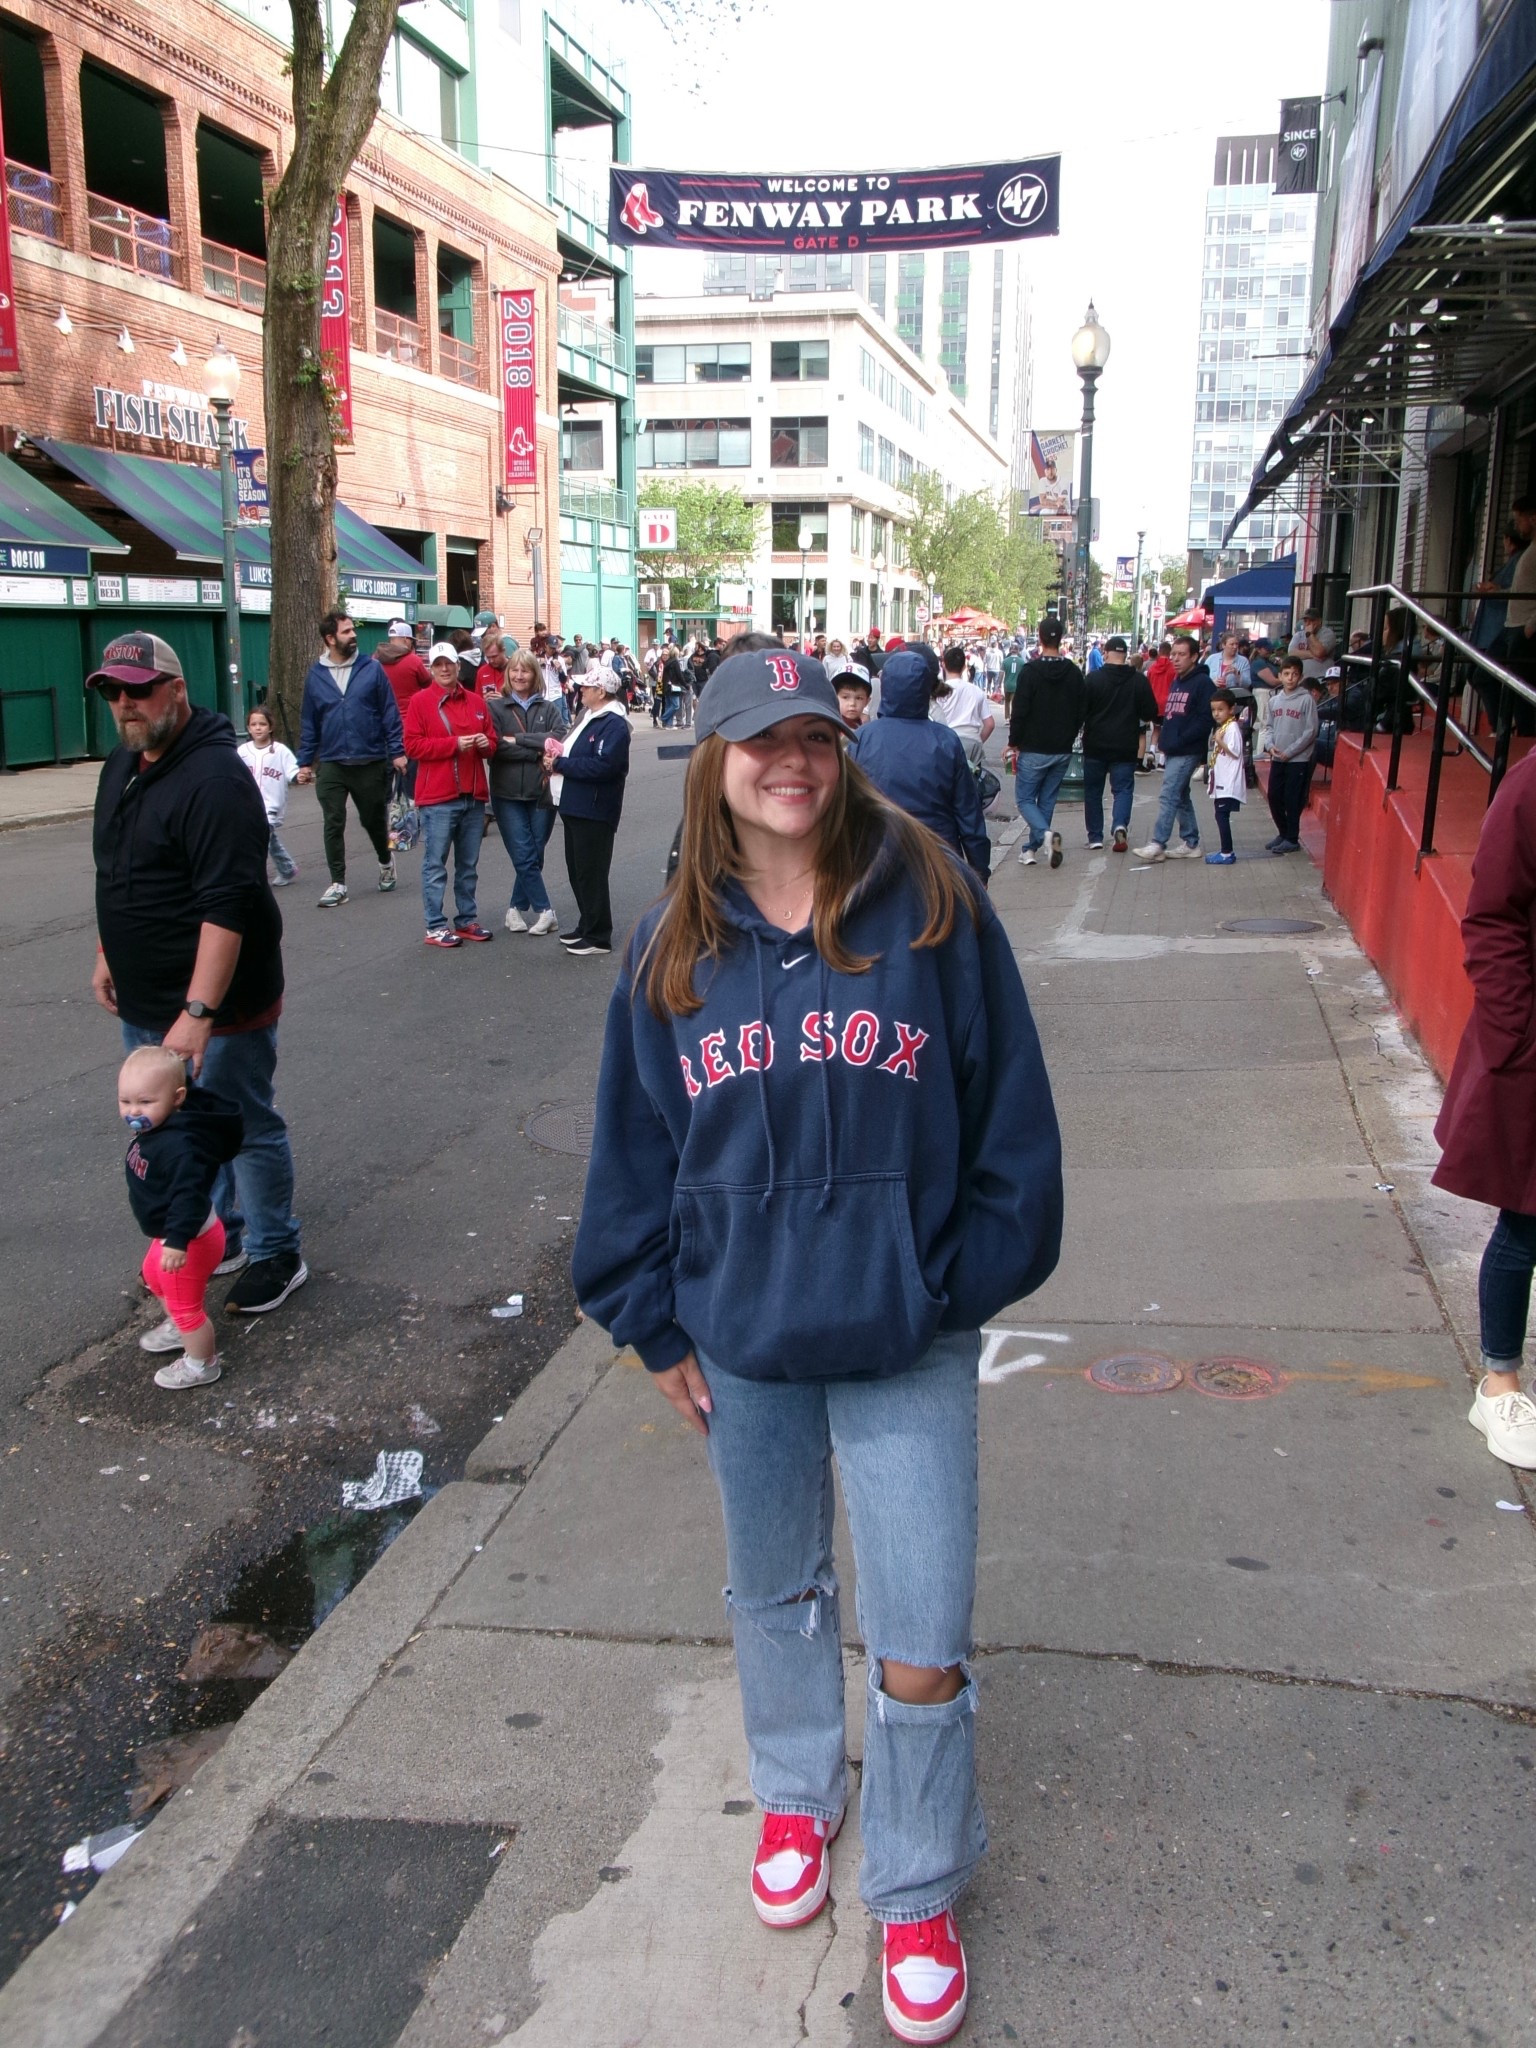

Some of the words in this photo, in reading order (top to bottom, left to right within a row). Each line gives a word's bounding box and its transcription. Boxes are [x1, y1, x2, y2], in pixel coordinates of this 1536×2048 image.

[1283, 129, 1317, 142] SINCE
[767, 177, 858, 193] WELCOME
[865, 176, 891, 191] TO
[677, 199, 851, 228] FENWAY
[860, 193, 983, 226] PARK
[793, 235, 839, 250] GATE
[848, 236, 860, 248] D
[503, 297, 532, 387] 2018
[94, 386, 164, 439] FISH
[167, 403, 249, 451] SHAK
[237, 466, 250, 478] IT'S
[238, 479, 253, 490] SOX
[238, 490, 266, 501] SEASON
[648, 524, 670, 544] D
[11, 548, 46, 569] BOSTON
[249, 565, 272, 584] LUKE'S
[99, 580, 107, 588] ICE
[107, 580, 120, 588] COLD
[352, 577, 373, 595] LUKE'S
[373, 580, 397, 597] LOBSTER
[100, 588, 121, 598] BEER
[203, 591, 220, 600] BEER
[104, 644, 144, 662] OSTON
[766, 654, 801, 691] B
[1285, 708, 1301, 720] SOX
[262, 766, 282, 781] SOX
[680, 1020, 775, 1101] RED
[800, 1010, 930, 1082] SOX
